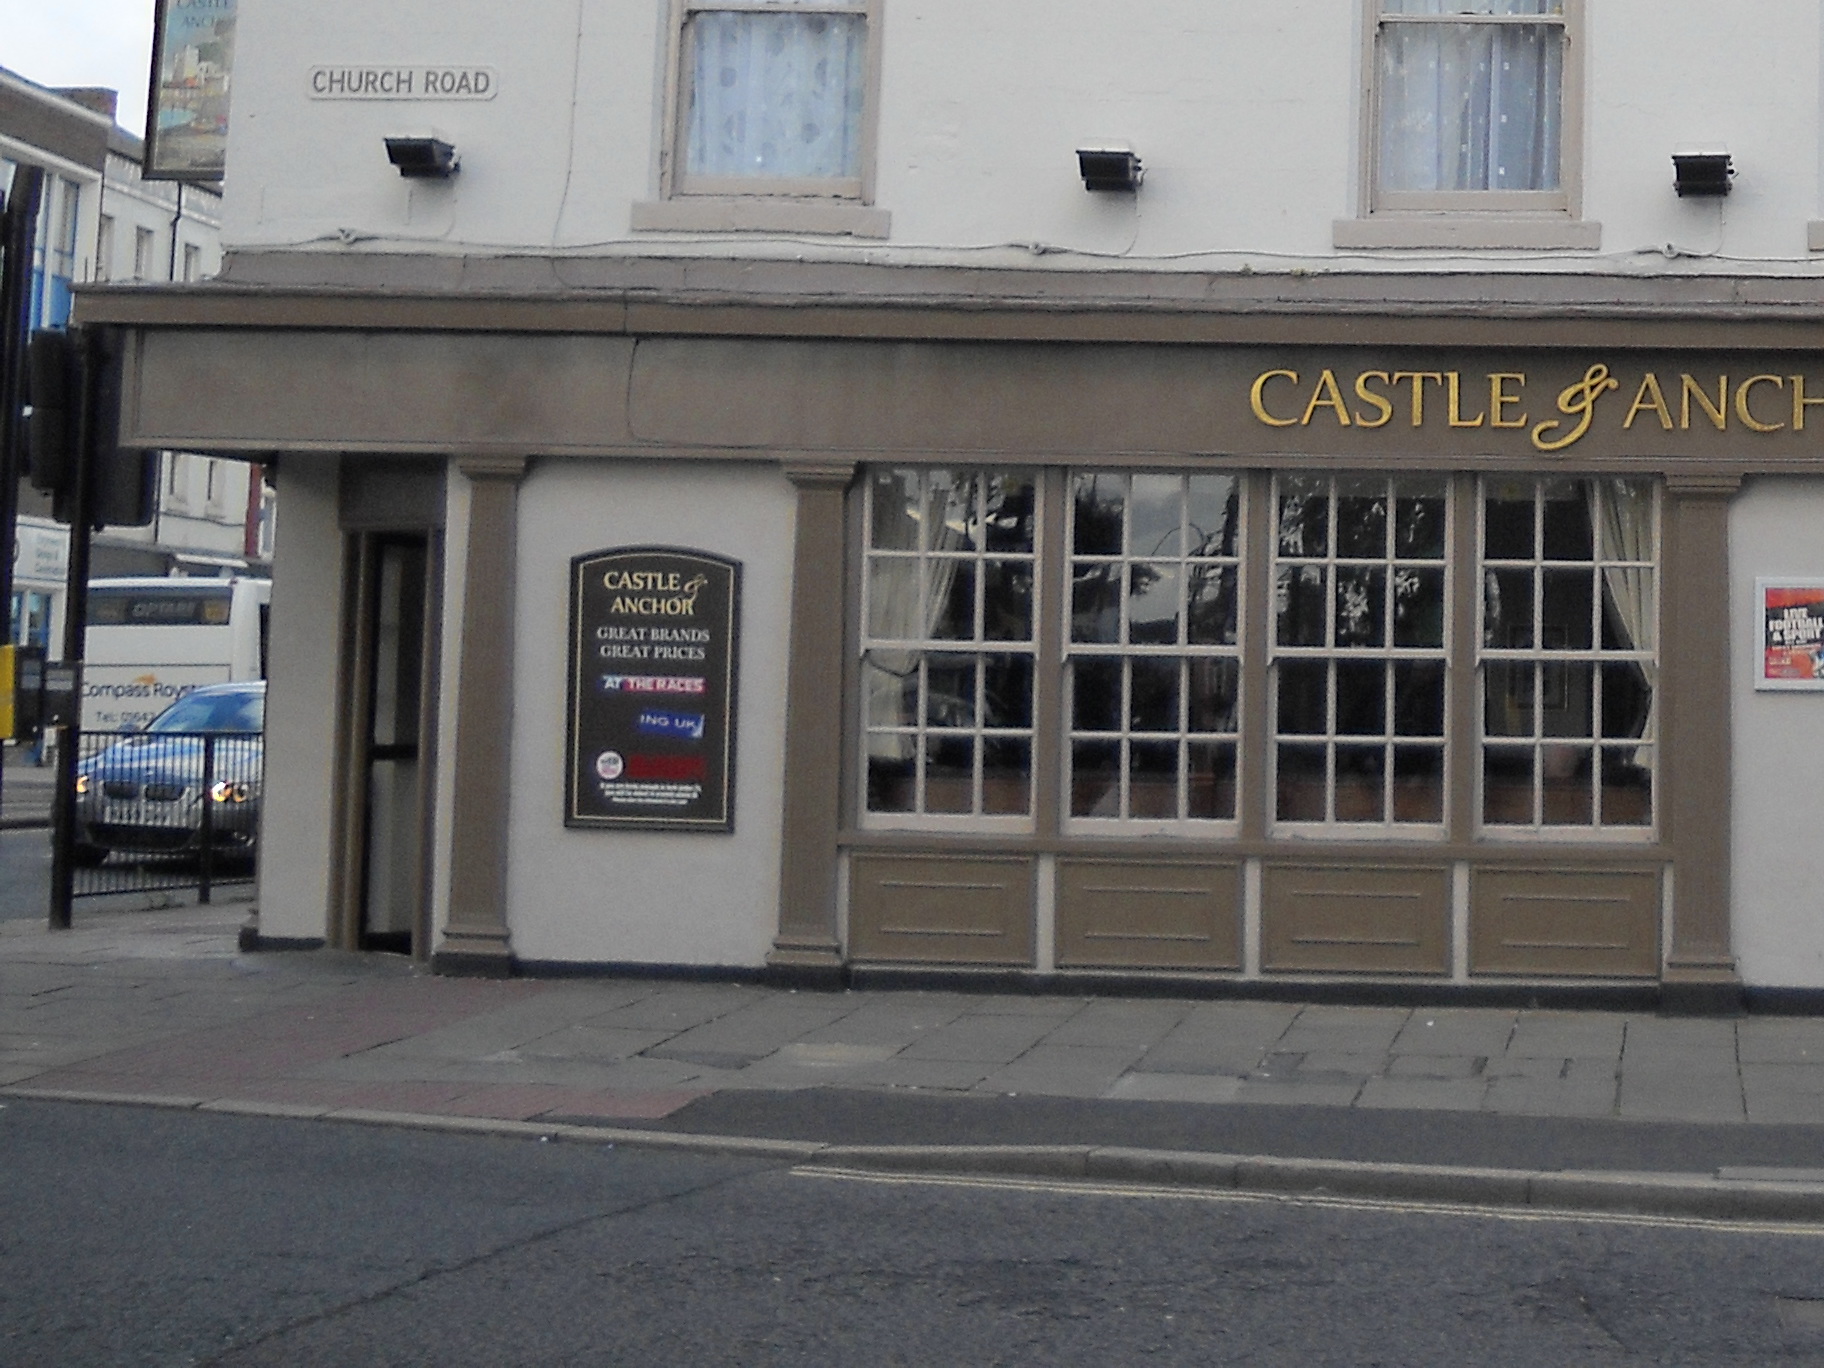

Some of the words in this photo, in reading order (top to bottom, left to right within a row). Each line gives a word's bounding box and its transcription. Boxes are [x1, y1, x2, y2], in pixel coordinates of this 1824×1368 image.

[313, 70, 413, 93] CHURCH
[424, 71, 490, 94] ROAD
[1250, 369, 1529, 428] CASTLE
[1530, 363, 1619, 452] &
[603, 571, 681, 591] CASTLE
[682, 573, 708, 601] &
[611, 596, 694, 615] ANCHOR
[1769, 617, 1824, 632] FOOTBALL
[596, 627, 648, 641] GREAT
[650, 628, 710, 642] BRANDS
[600, 645, 651, 659] GREAT
[653, 646, 706, 660] PRICES
[82, 683, 151, 700] Compass
[604, 678, 623, 690] AT
[628, 678, 654, 691] THE
[656, 678, 704, 693] RACES
[640, 714, 670, 727] ING
[674, 718, 696, 730] UK
